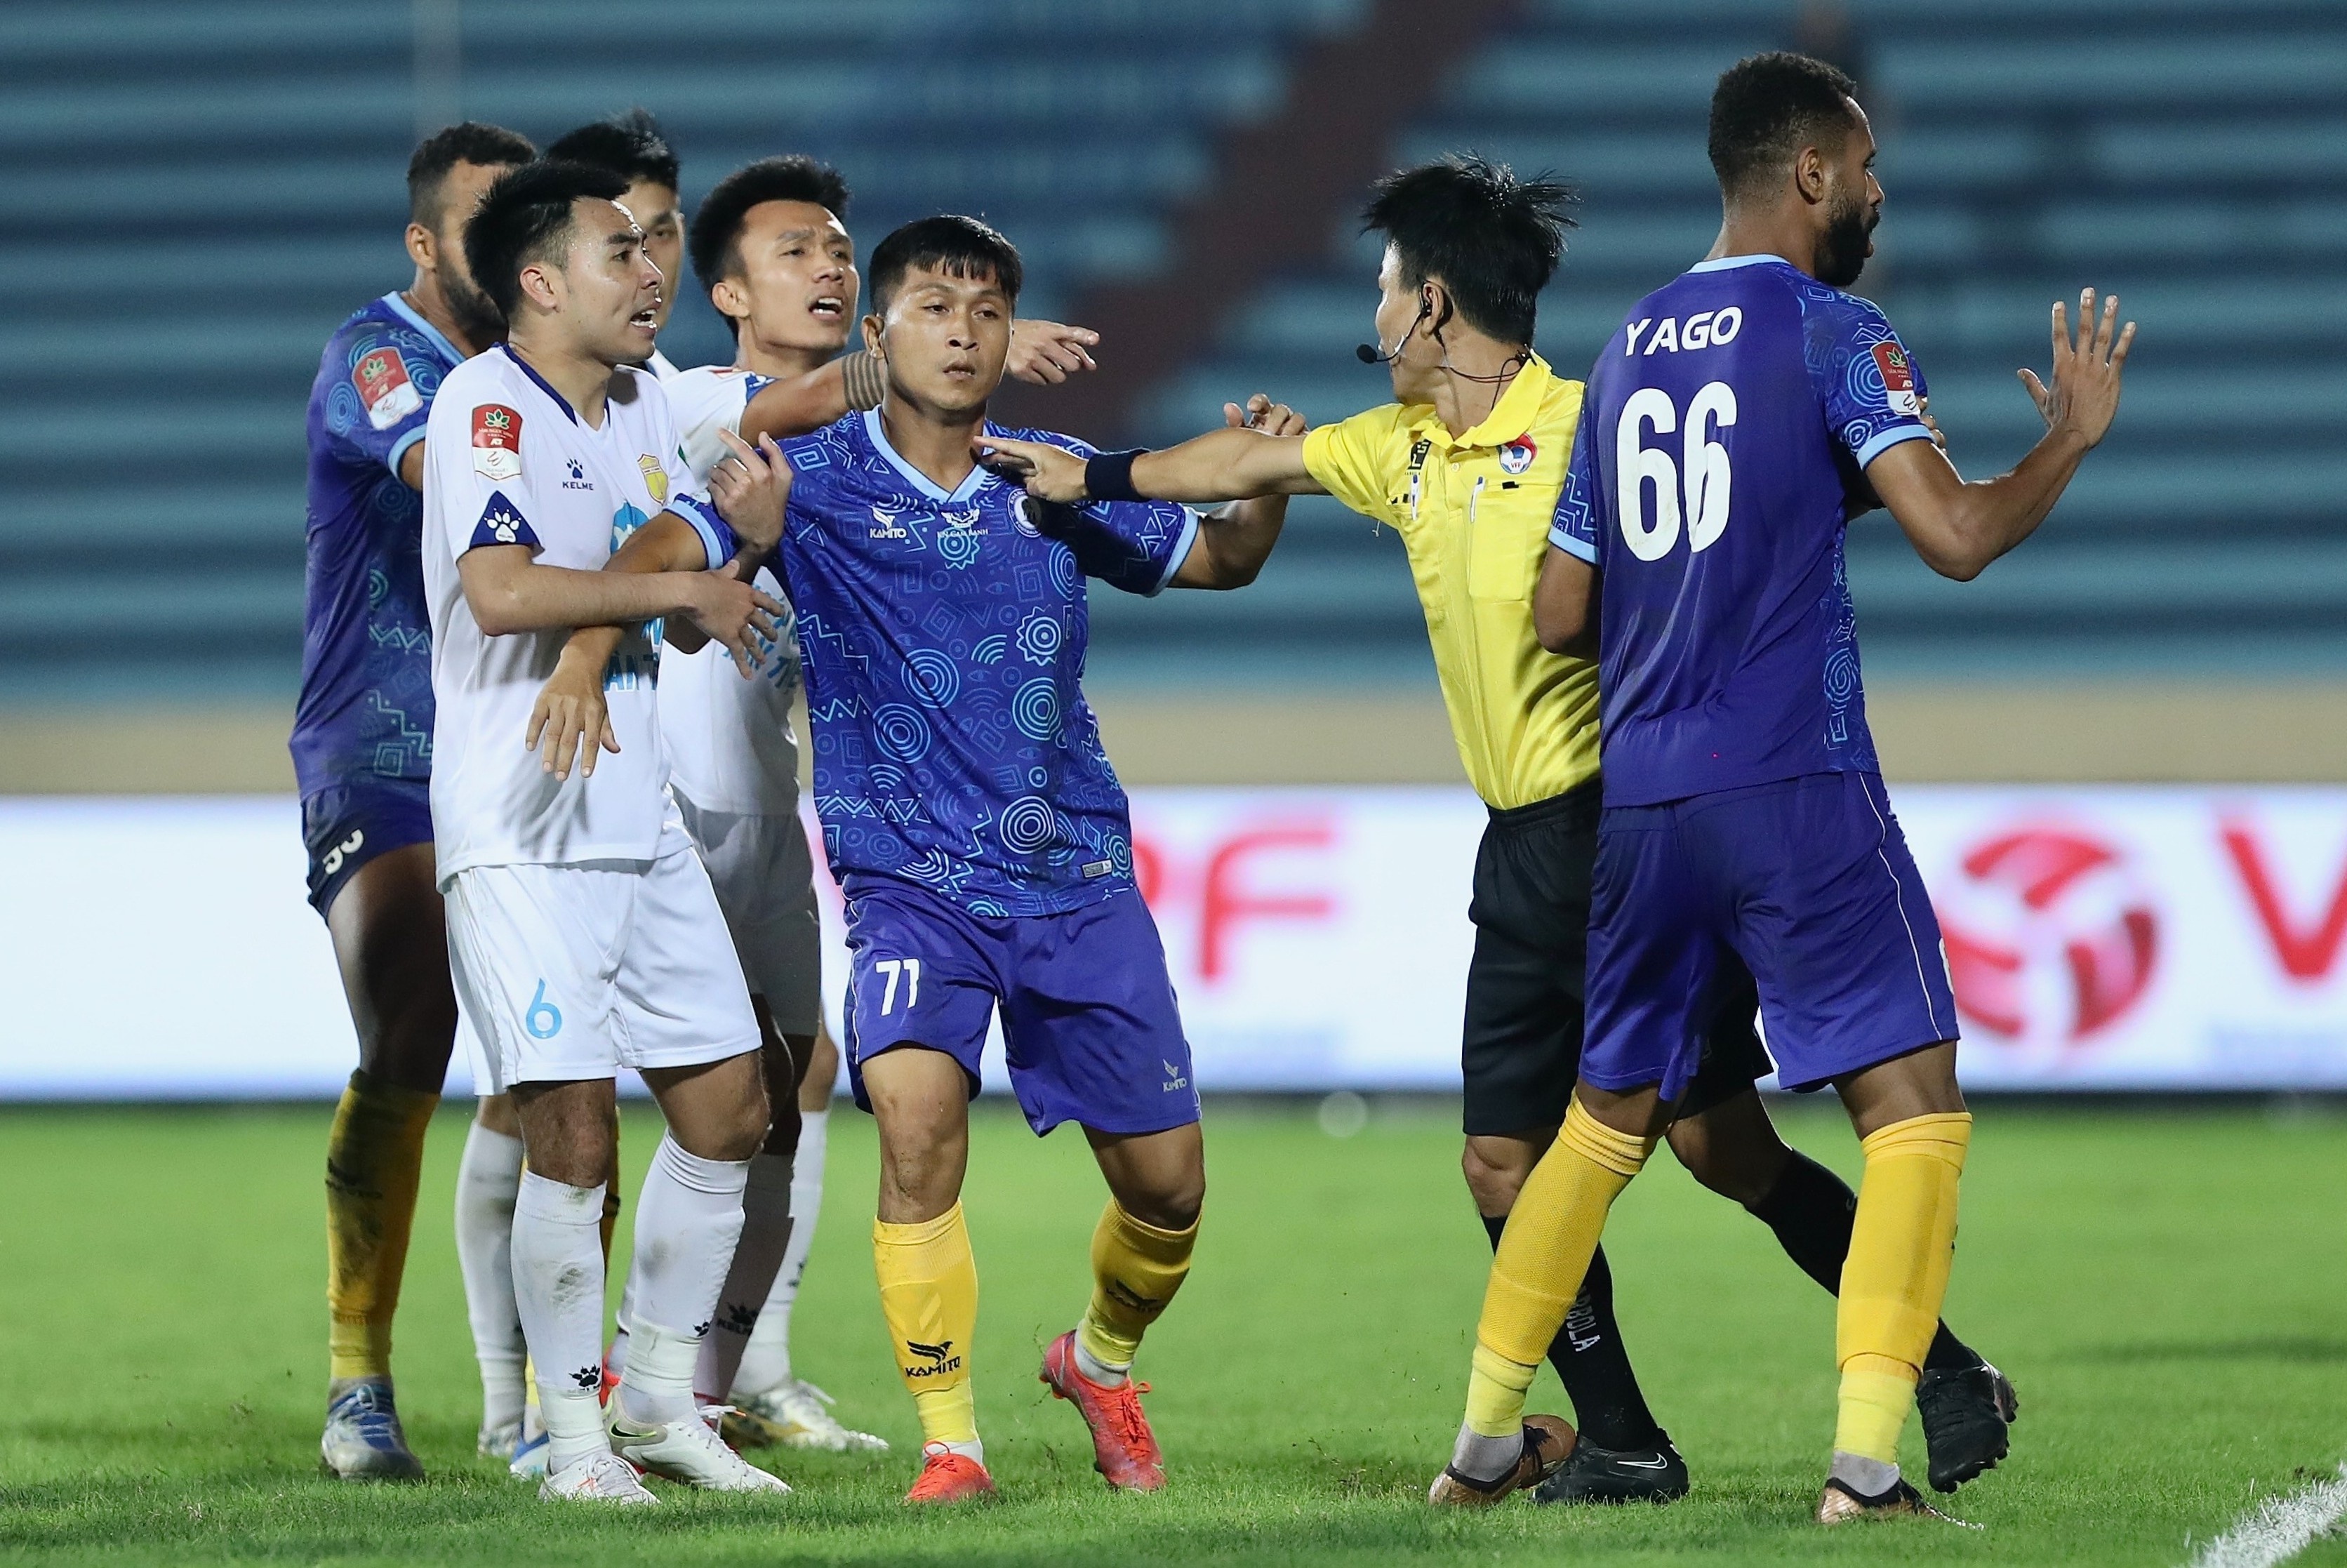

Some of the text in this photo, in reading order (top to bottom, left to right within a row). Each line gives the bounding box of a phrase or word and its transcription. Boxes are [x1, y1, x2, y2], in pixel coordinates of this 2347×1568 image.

[1625, 307, 1743, 357] YAGO
[562, 481, 594, 491] KELME
[1617, 381, 1738, 562] 66
[870, 528, 907, 538] KAMITO
[875, 958, 920, 1016] 71
[526, 976, 562, 1039] 6
[1162, 1077, 1187, 1093] KAMITO
[905, 1355, 961, 1377] KAMITO
